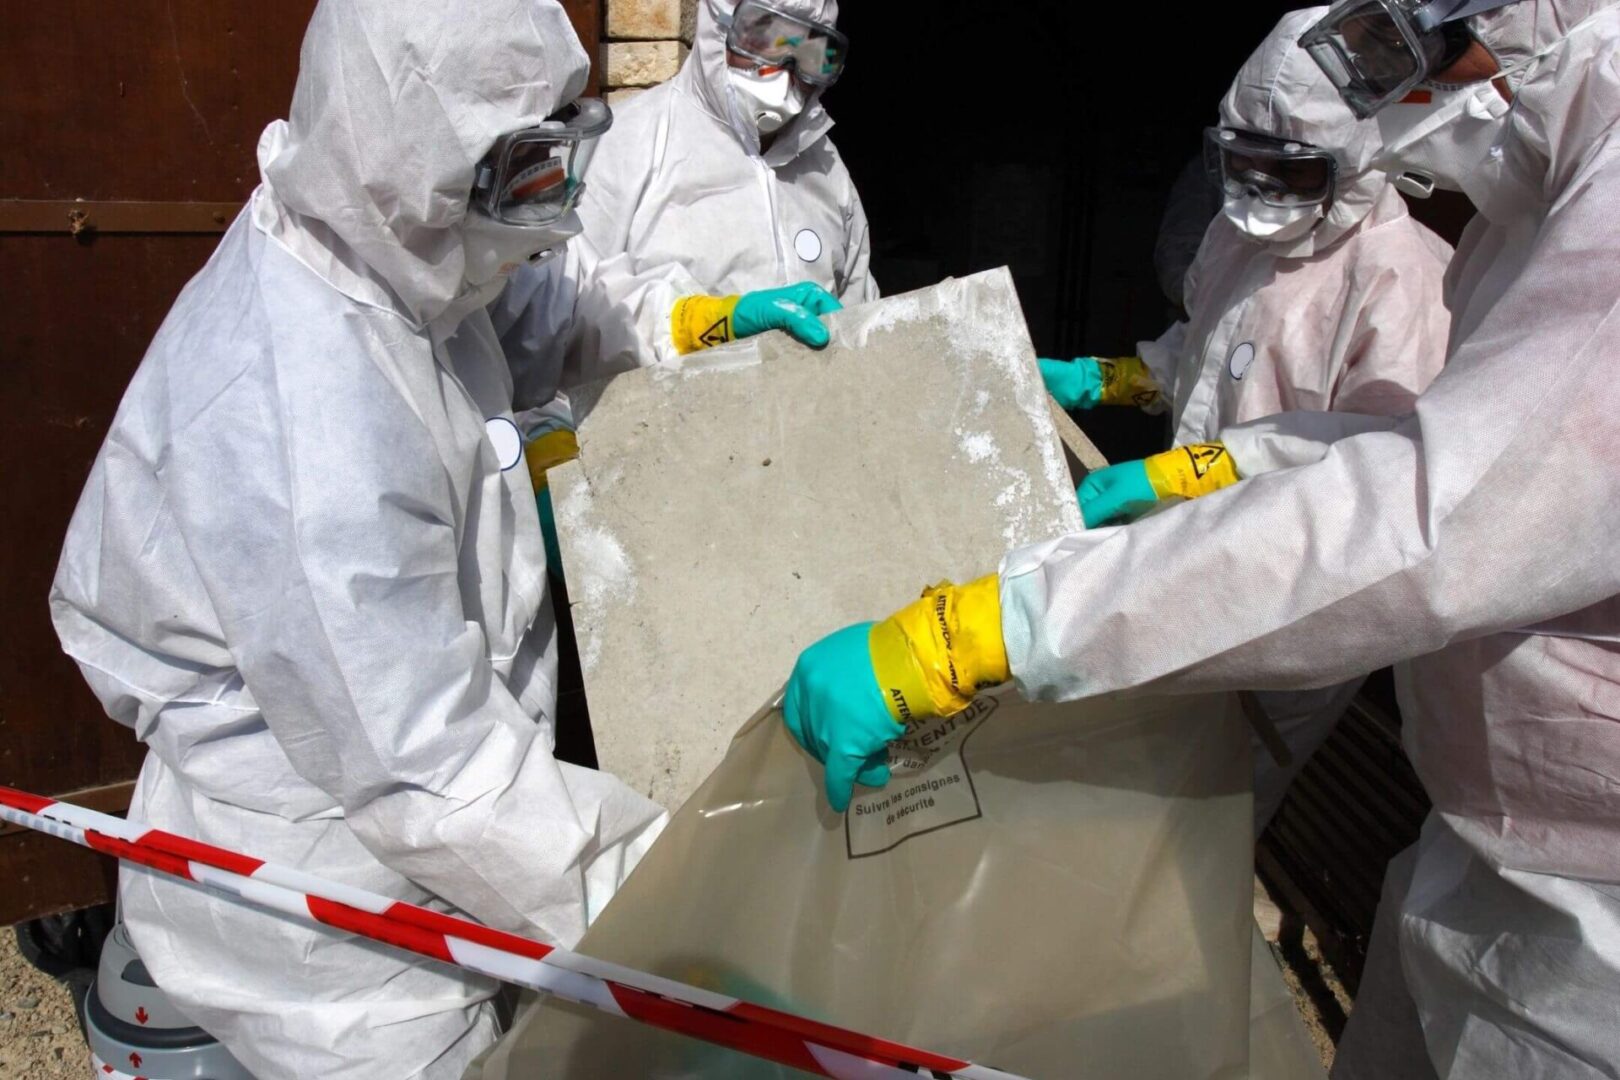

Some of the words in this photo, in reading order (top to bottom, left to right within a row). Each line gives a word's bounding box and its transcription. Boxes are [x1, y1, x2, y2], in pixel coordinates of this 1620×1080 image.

[890, 688, 912, 720] ATTEN
[964, 699, 987, 720] DE
[855, 799, 891, 816] Suivre
[890, 792, 903, 804] les
[904, 774, 961, 798] consignes
[886, 812, 897, 826] de
[896, 797, 935, 819] sécurité
